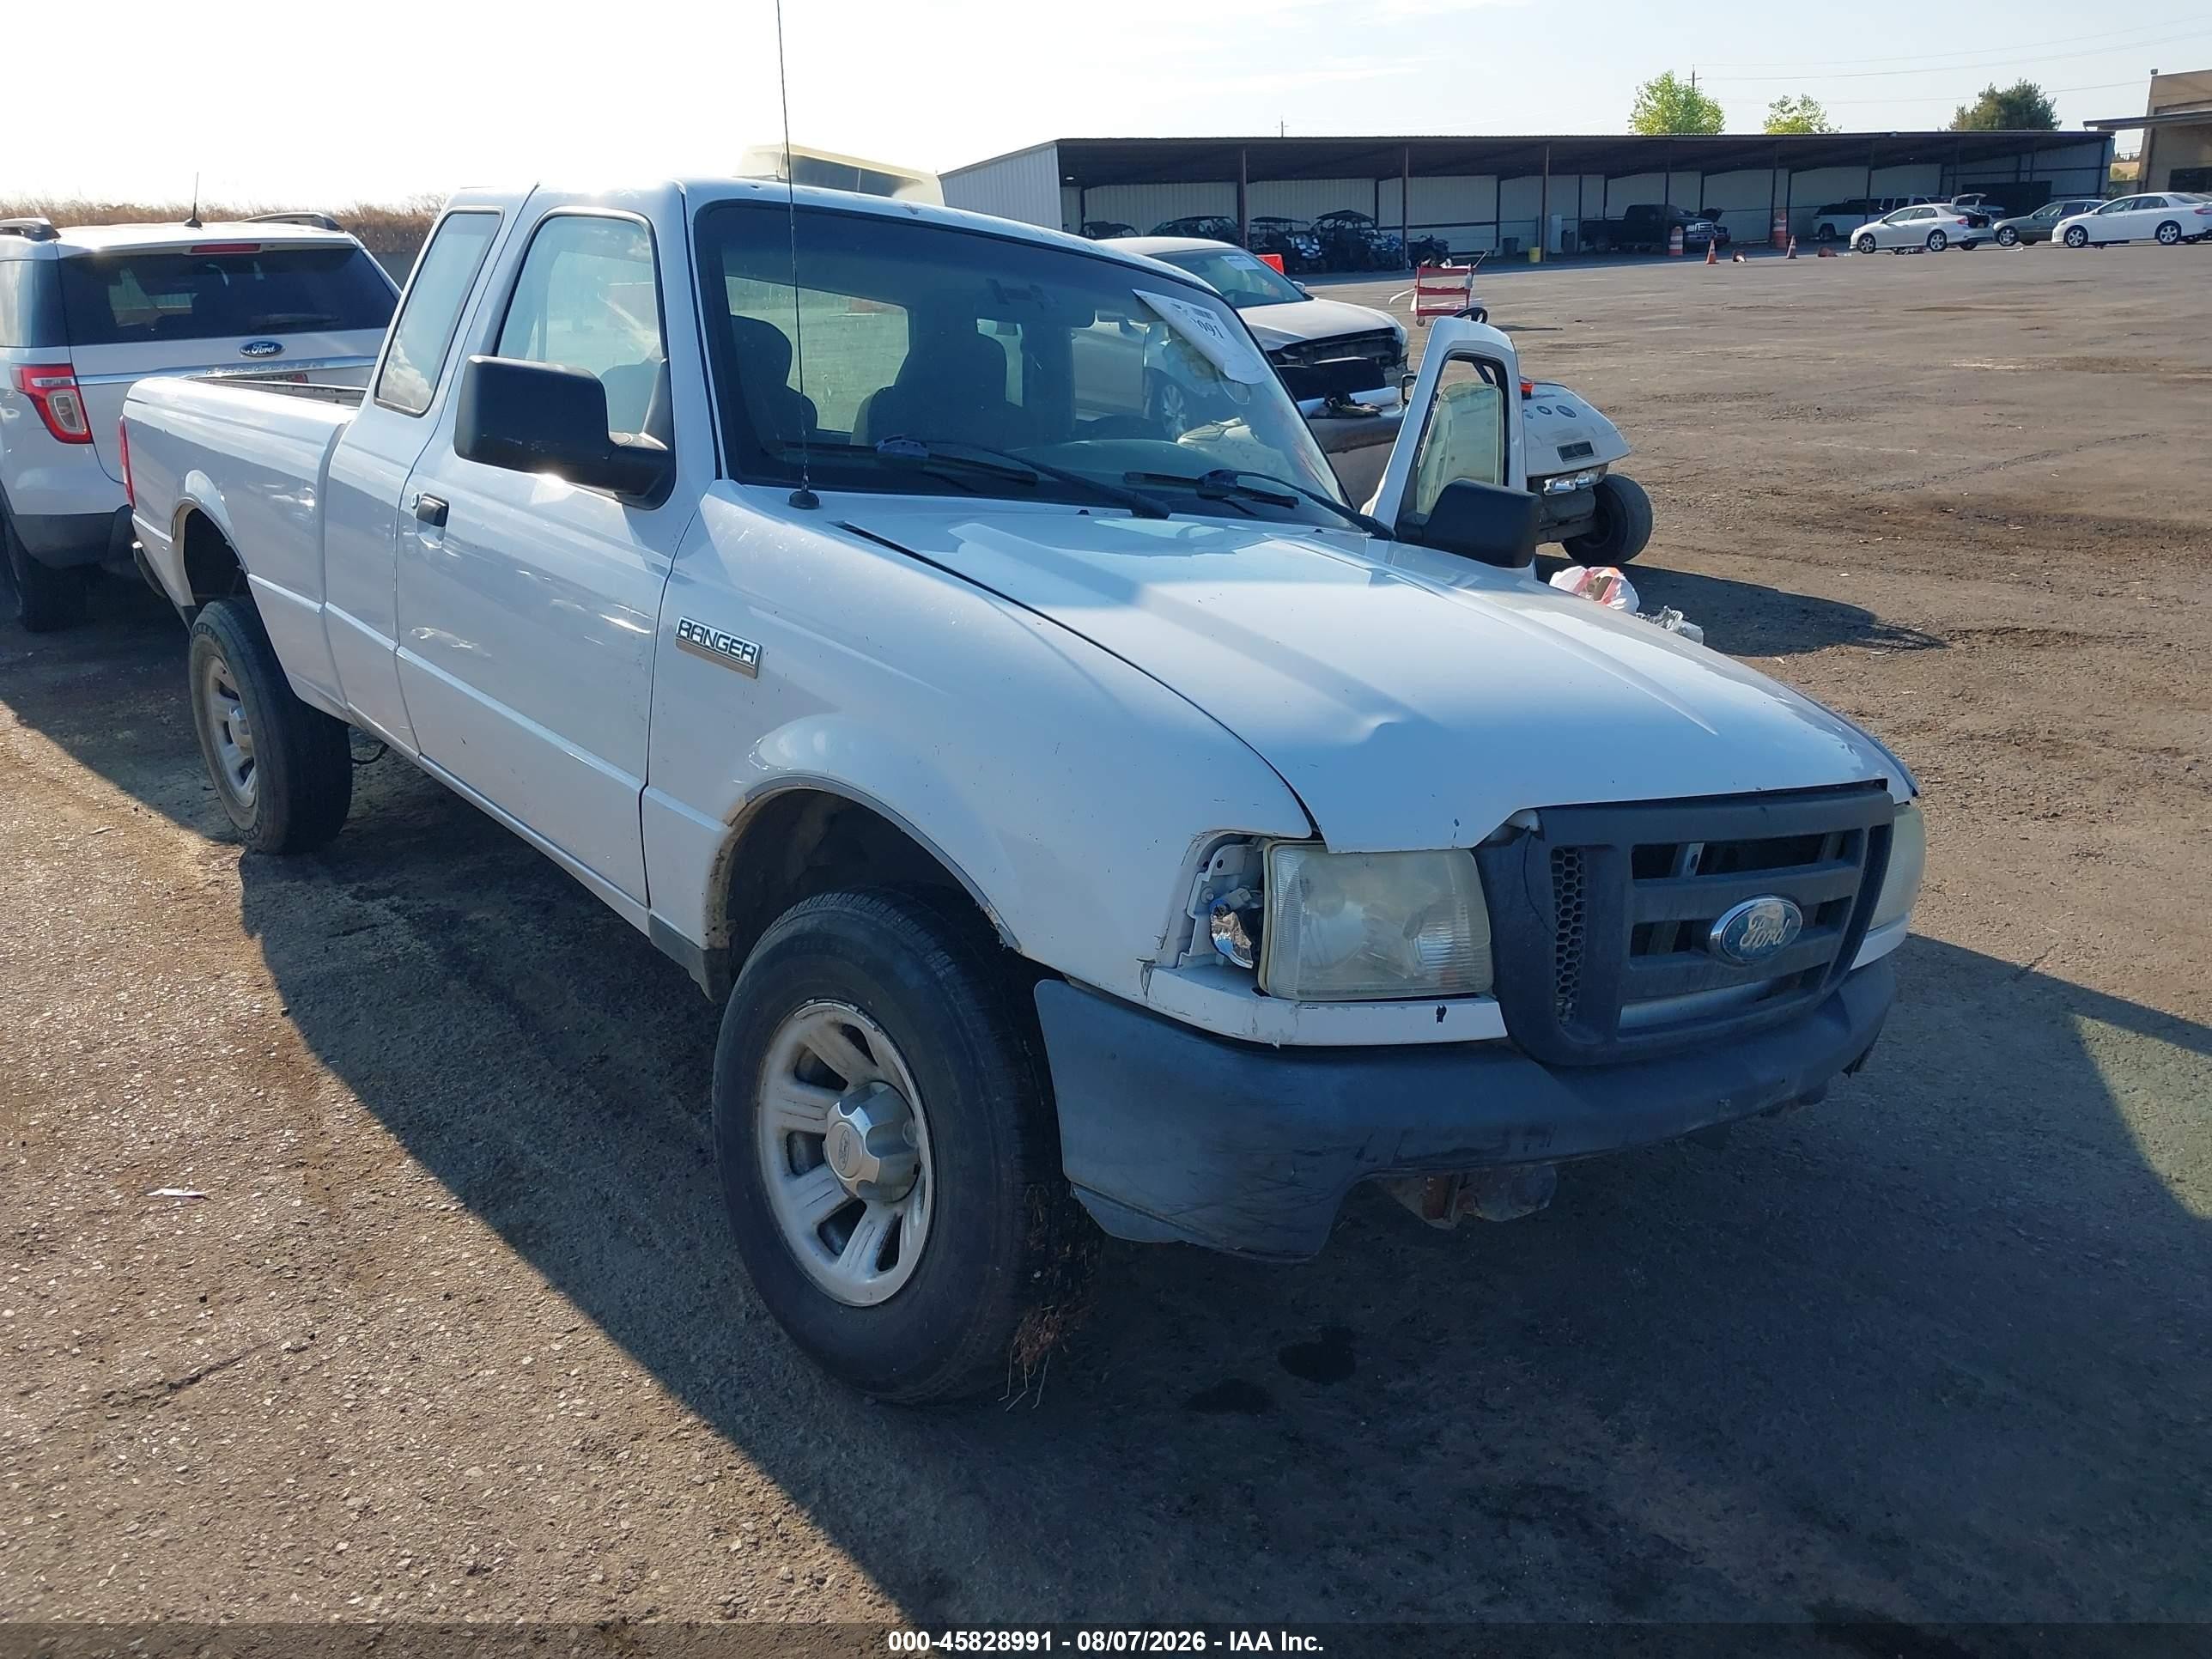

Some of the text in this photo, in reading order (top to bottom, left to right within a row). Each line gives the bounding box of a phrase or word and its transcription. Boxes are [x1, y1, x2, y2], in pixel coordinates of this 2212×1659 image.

[251, 343, 276, 355] Ford
[677, 618, 757, 664] RANGER
[1739, 910, 1791, 951] Ford
